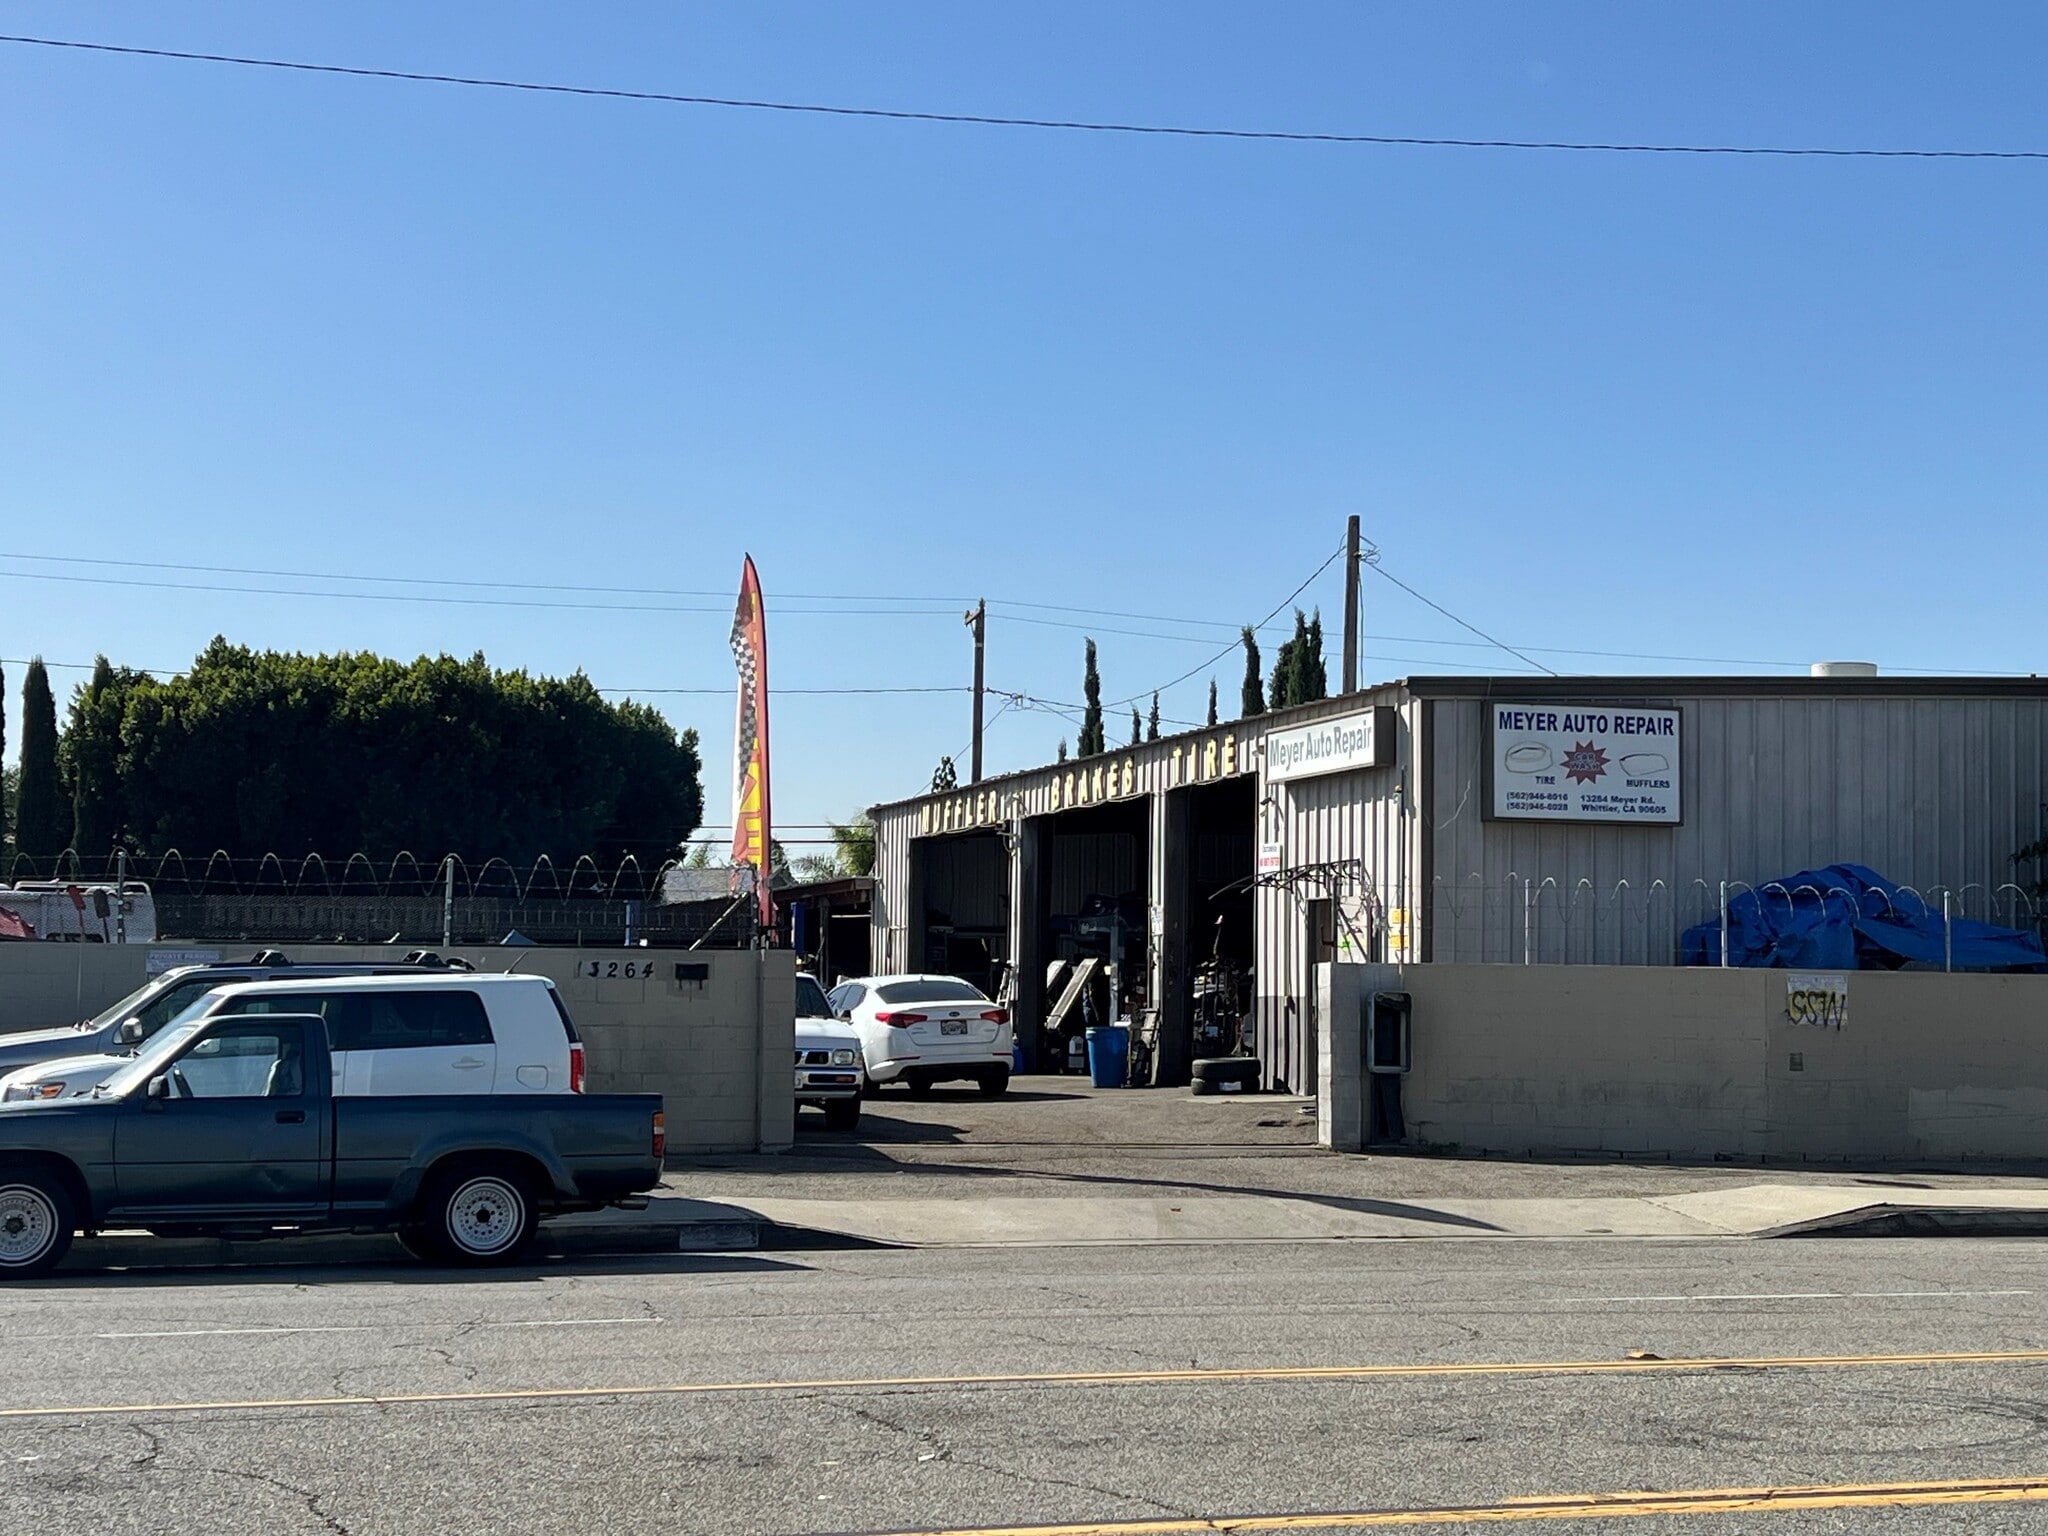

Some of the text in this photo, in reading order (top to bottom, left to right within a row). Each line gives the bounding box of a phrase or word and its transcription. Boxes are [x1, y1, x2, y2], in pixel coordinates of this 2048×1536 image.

[1499, 711, 1674, 736] MEYER AUTO REPAIR
[1269, 719, 1372, 771] Meyer Auto Repair
[1574, 753, 1595, 761] CAR
[1570, 762, 1600, 770] WASH
[1051, 757, 1134, 811] BRAKES
[1172, 735, 1236, 783] TIRE
[1535, 776, 1556, 785] TIRE
[1626, 779, 1670, 788] MUFFLERS
[1611, 795, 1638, 805] Meyer
[1623, 805, 1636, 813] CA
